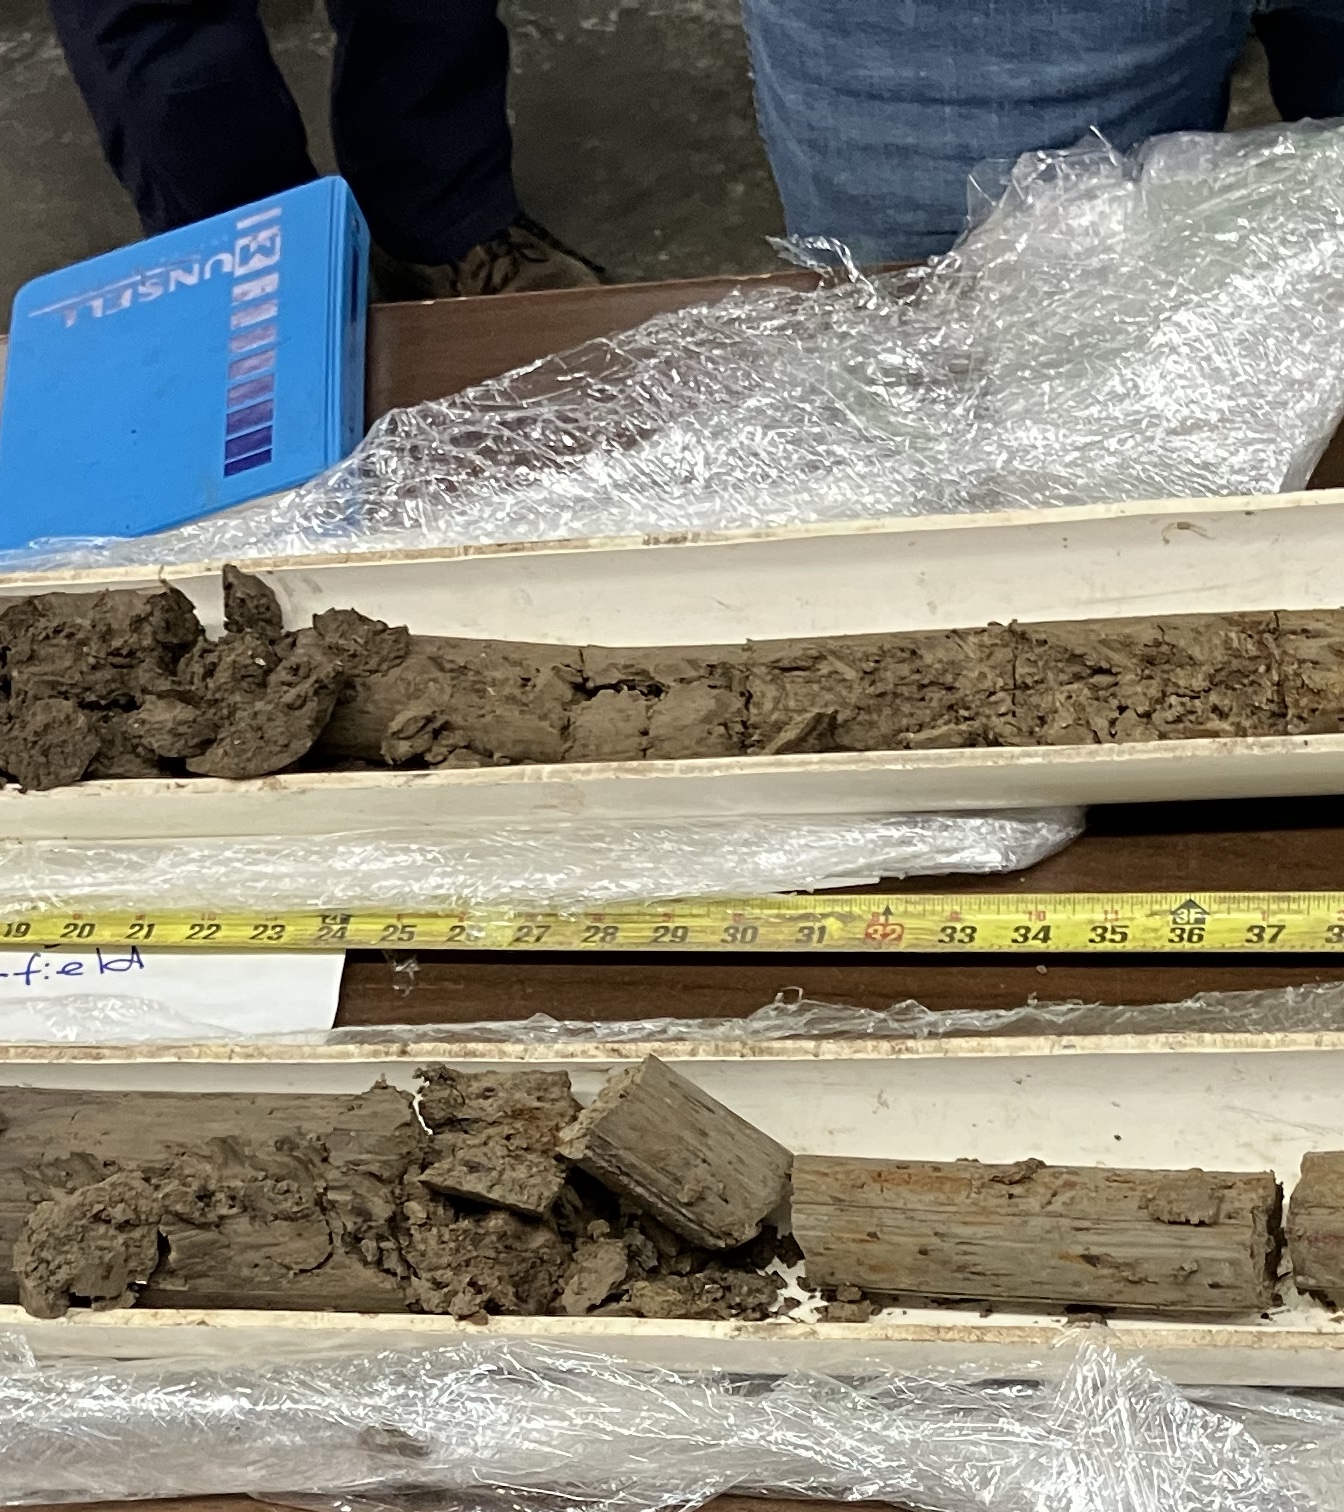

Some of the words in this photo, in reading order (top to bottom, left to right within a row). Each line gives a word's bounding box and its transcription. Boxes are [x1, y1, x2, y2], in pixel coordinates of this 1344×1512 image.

[1175, 909, 1202, 923] 3F
[3, 922, 32, 938] 19
[59, 923, 96, 939] 20
[124, 923, 156, 940] 21
[185, 924, 222, 941] 22
[249, 924, 286, 941] 23
[314, 926, 348, 942] 24
[379, 925, 417, 942] 25
[509, 925, 552, 944] 27
[580, 925, 620, 944] 28
[649, 925, 689, 944] 29
[720, 925, 759, 944] 30
[795, 925, 828, 944] 31
[867, 925, 903, 943] 32
[937, 925, 977, 944] 33
[1011, 925, 1052, 944] 34
[1088, 925, 1129, 944] 35
[1168, 926, 1206, 944] 36
[1245, 925, 1286, 944] 37
